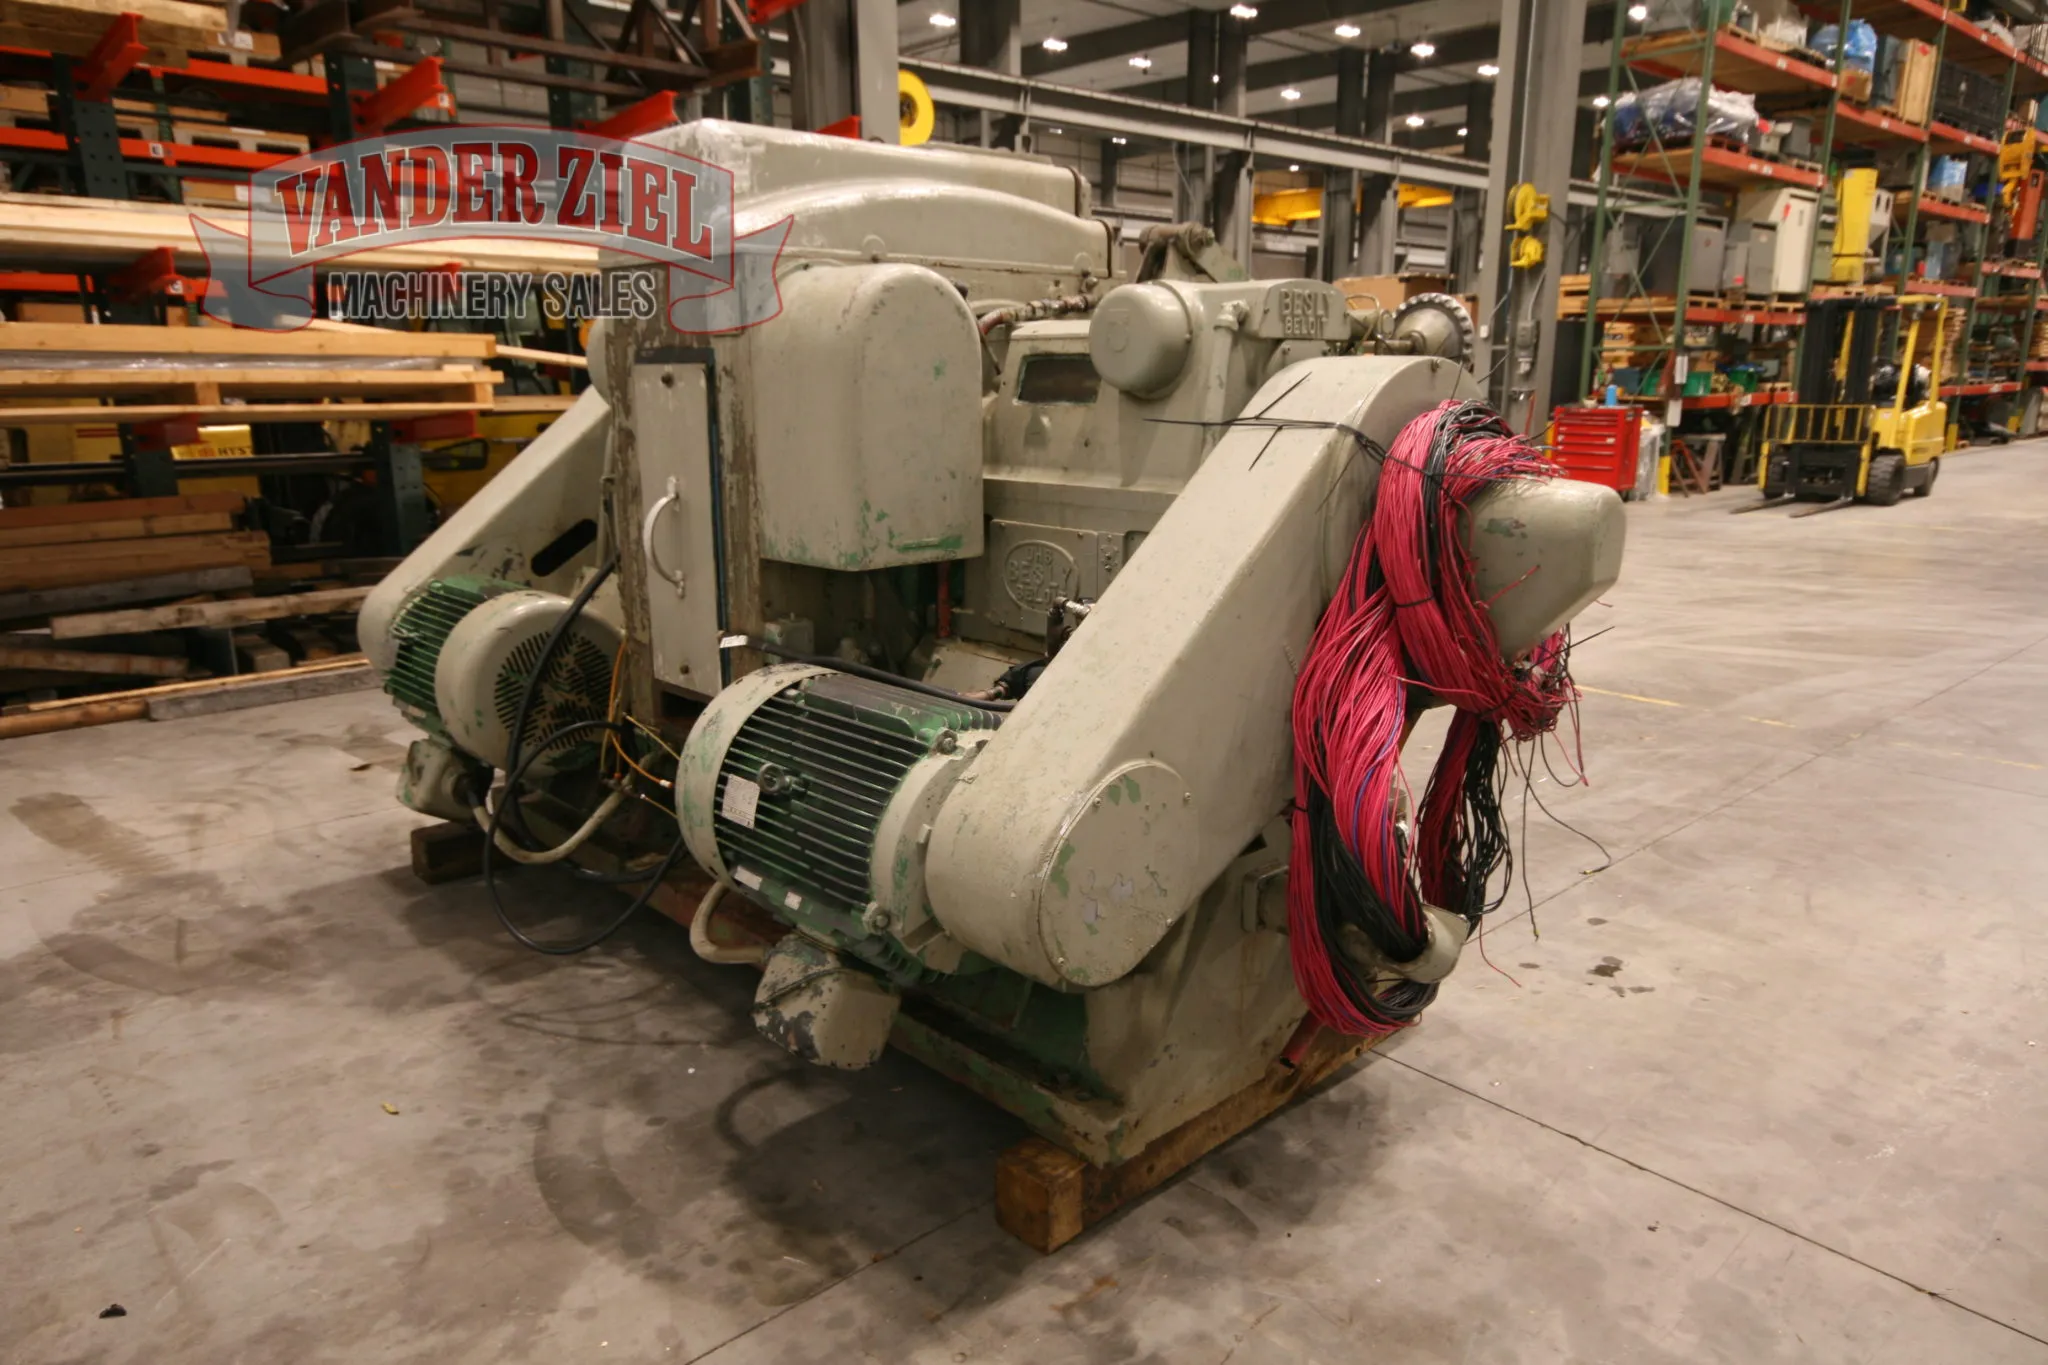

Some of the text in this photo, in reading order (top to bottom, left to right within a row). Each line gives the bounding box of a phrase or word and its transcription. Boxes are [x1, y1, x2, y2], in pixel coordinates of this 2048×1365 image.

[1278, 287, 1336, 317] BESLY
[1283, 316, 1330, 337] BELOIT
[1008, 559, 1073, 590] BESLY
